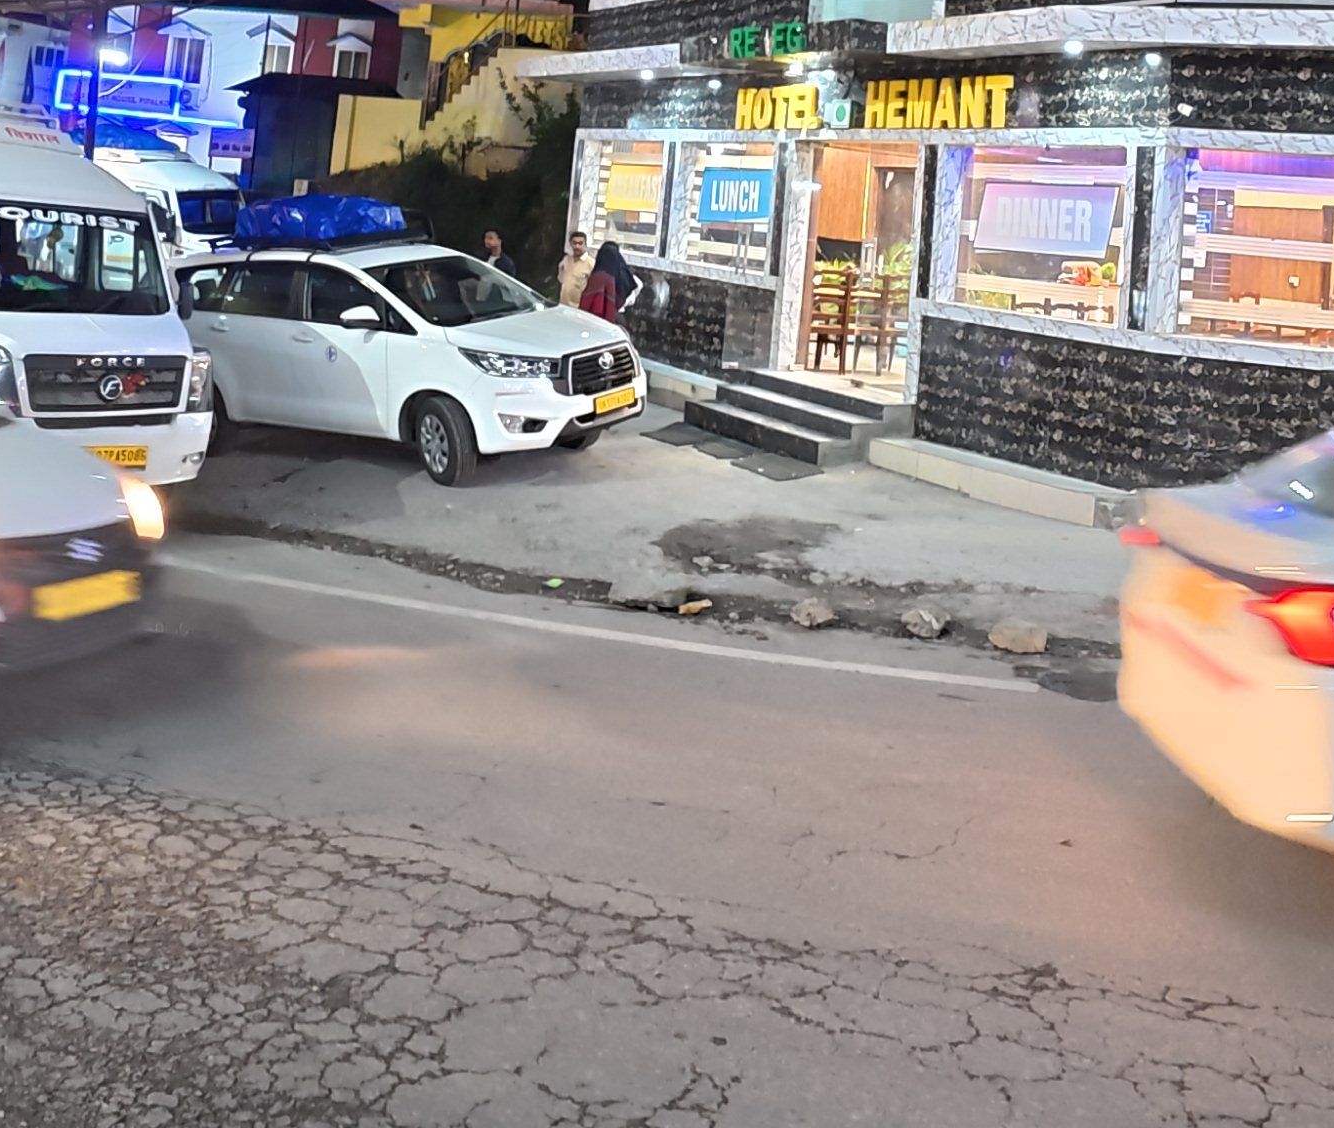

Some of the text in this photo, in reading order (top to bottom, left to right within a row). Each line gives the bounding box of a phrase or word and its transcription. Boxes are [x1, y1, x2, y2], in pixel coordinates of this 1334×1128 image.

[735, 75, 1015, 130] HOTEL HEMANT
[710, 179, 761, 213] LUNCH
[997, 195, 1093, 243] DINNER
[76, 357, 146, 367] FORCE
